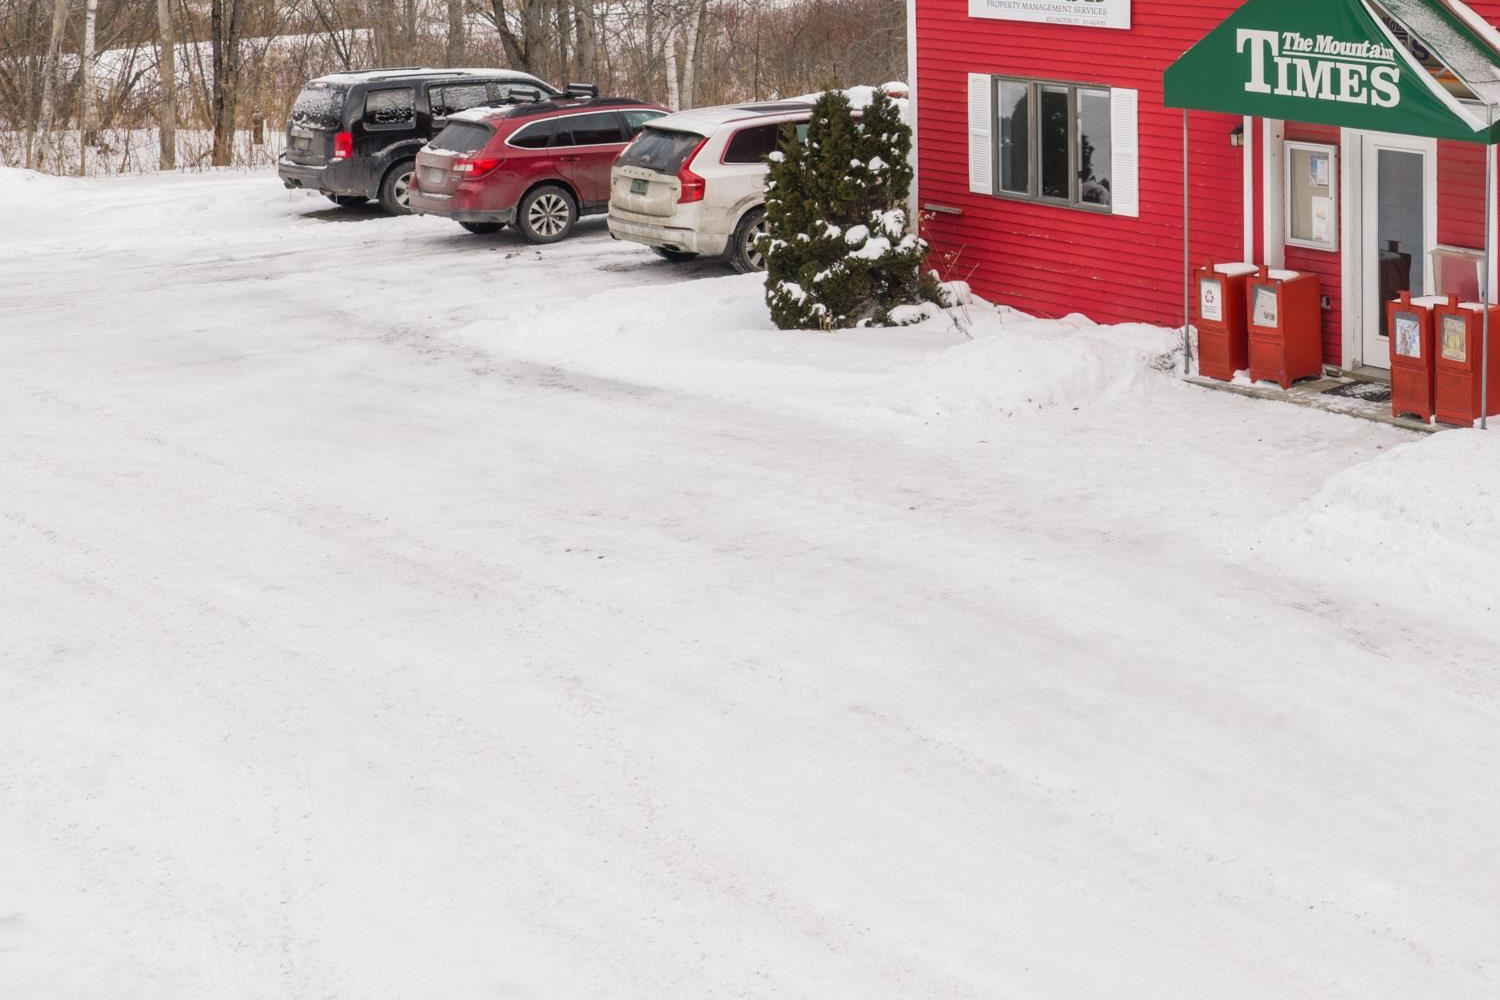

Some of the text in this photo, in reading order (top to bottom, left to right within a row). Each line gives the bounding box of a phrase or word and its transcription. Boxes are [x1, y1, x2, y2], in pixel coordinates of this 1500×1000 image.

[986, 0, 1107, 15] PROPERTY MANAGEMENT SERVICES
[1282, 31, 1313, 52] The
[1315, 34, 1394, 62] Mountain
[1236, 28, 1401, 108] TIMES
